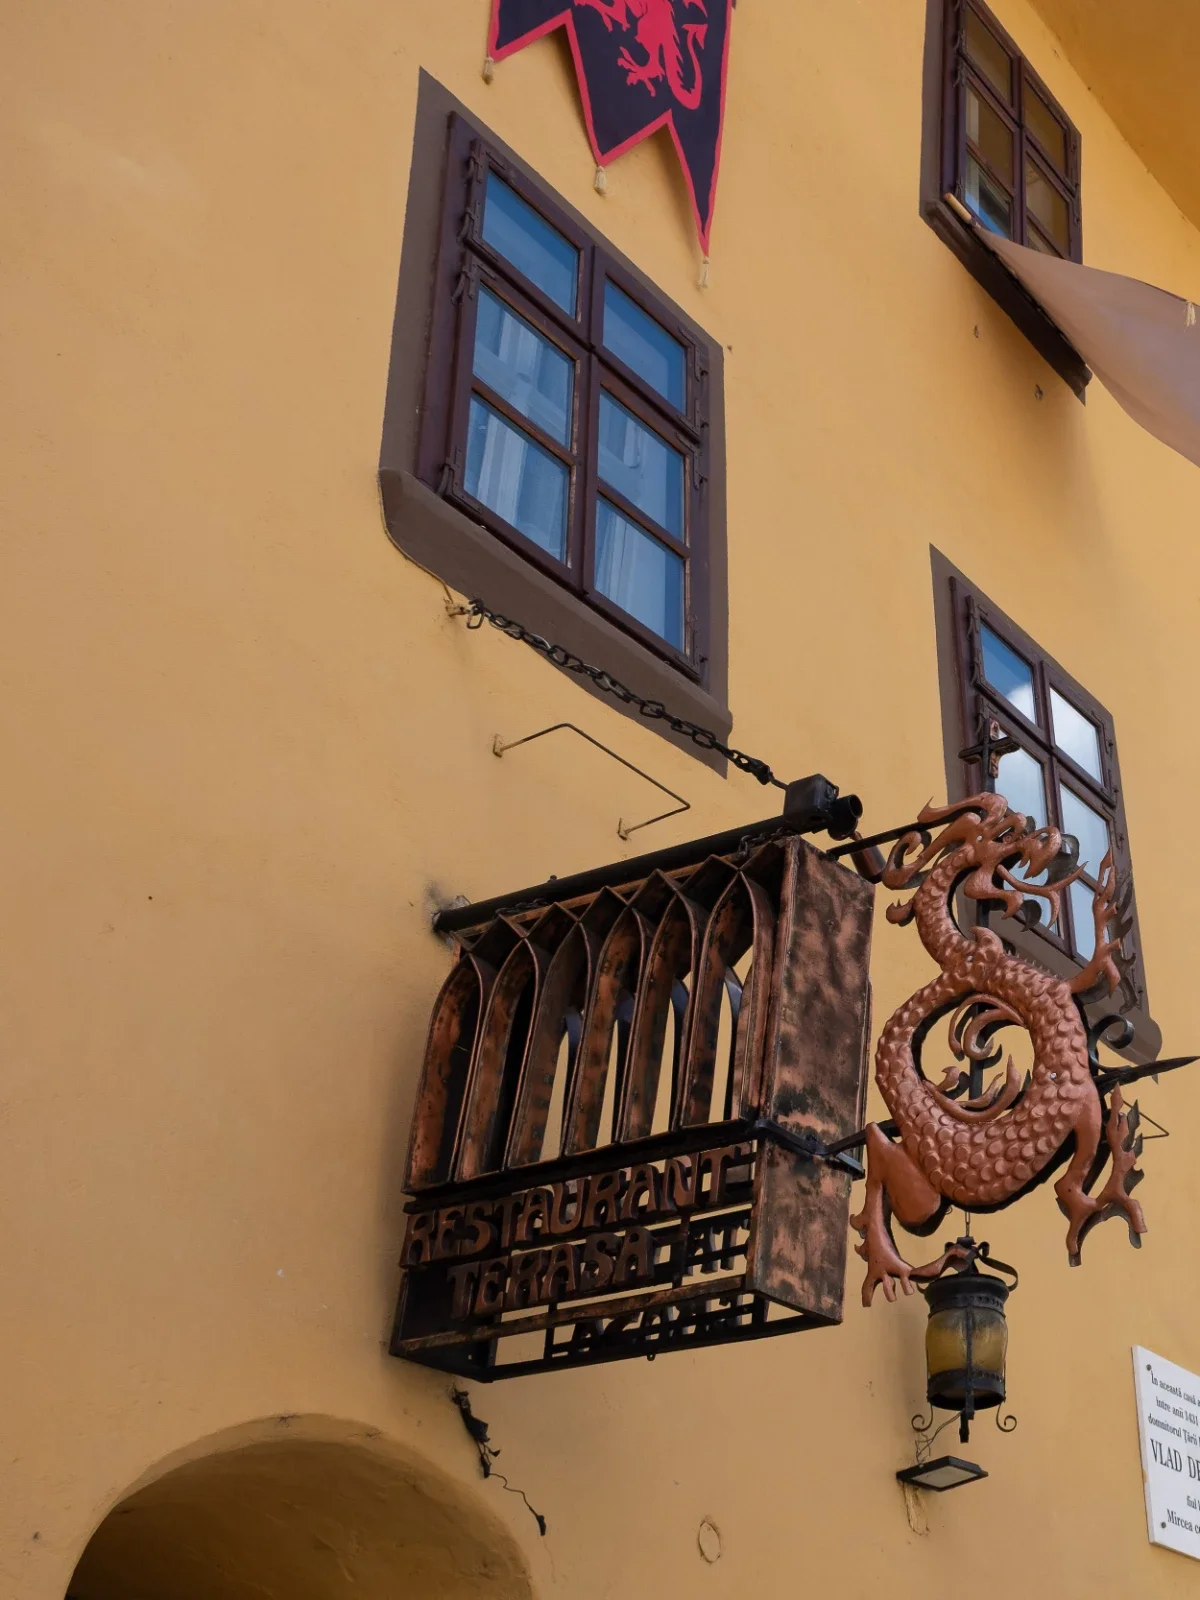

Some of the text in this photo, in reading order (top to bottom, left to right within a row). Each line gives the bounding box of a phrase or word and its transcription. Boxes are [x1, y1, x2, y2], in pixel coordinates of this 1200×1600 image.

[399, 1146, 738, 1269] RESTAURANT
[449, 1227, 653, 1320] TERASA
[1160, 1381, 1182, 1398] această
[1183, 1393, 1196, 1406] casă
[1148, 1413, 1181, 1438] domnitorul
[1172, 1407, 1184, 1420] anii
[1185, 1411, 1199, 1426] 1431
[1150, 1438, 1182, 1472] VLAD
[1186, 1496, 1197, 1510] fiul
[1167, 1509, 1193, 1532] Mircea
